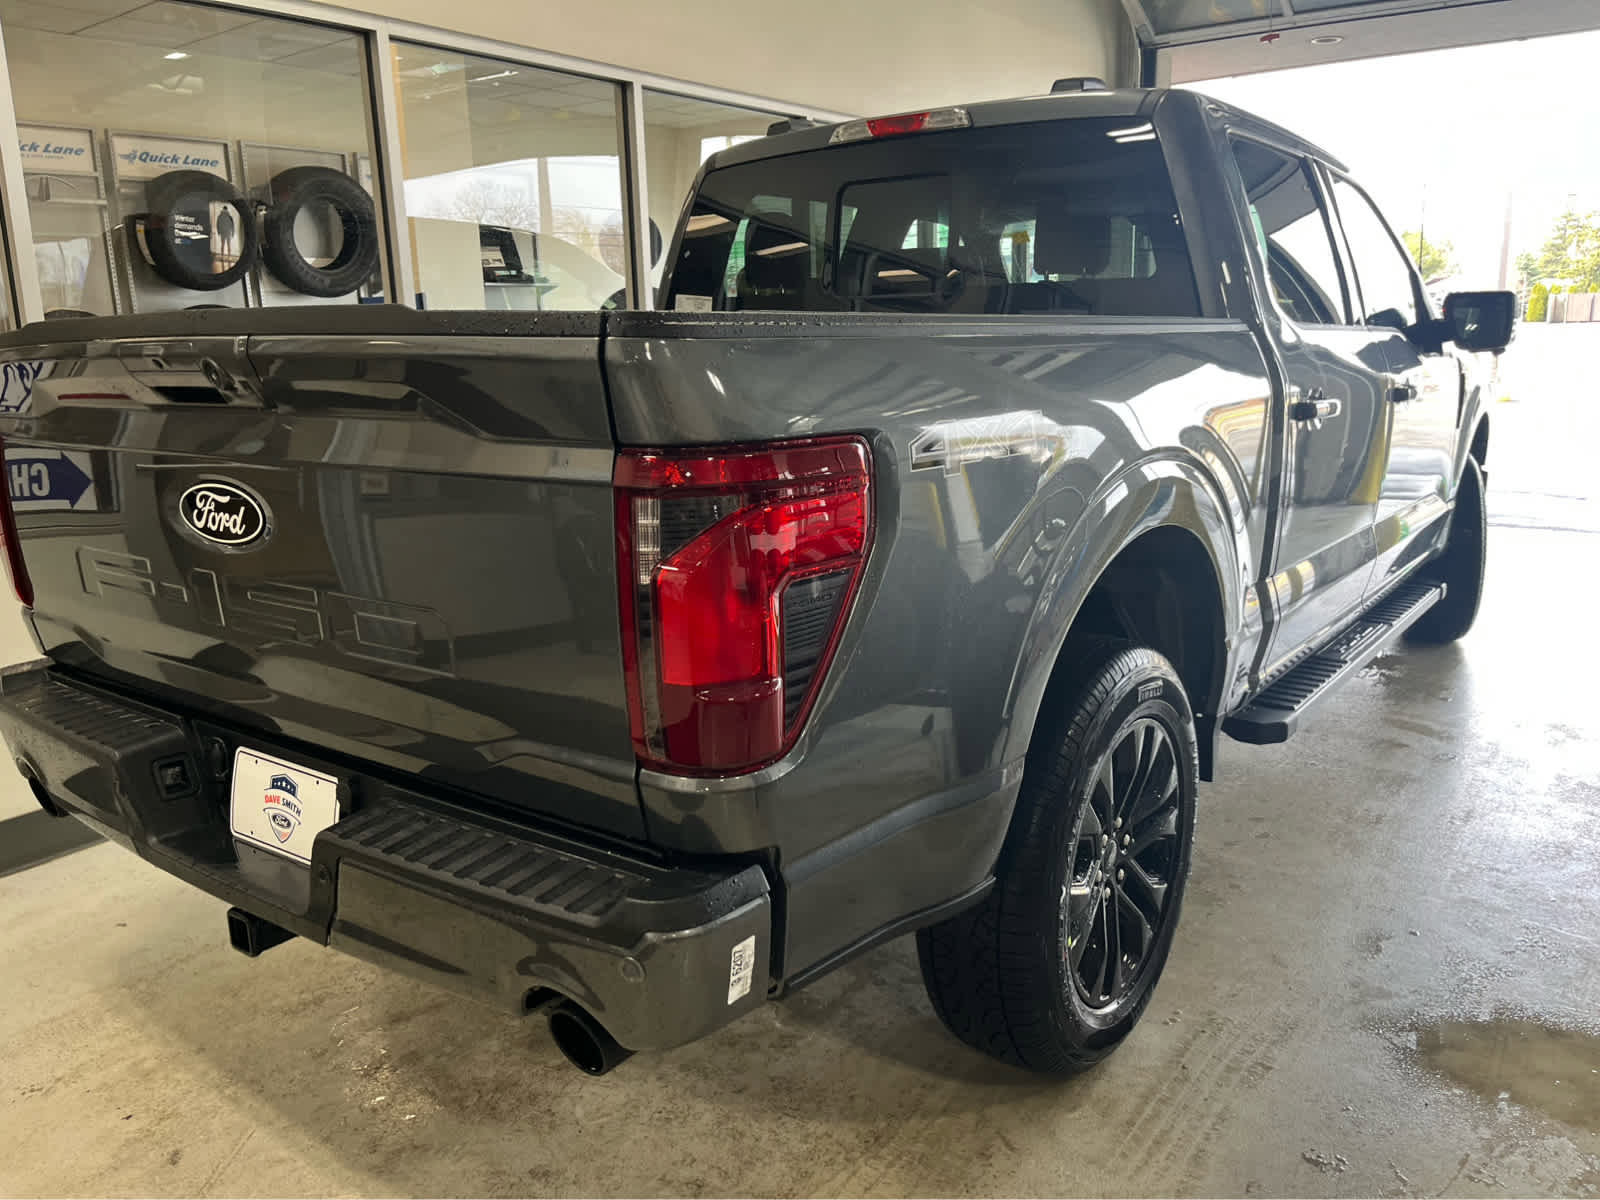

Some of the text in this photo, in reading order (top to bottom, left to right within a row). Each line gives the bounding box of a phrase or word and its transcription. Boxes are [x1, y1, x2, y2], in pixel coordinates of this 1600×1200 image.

[43, 143, 85, 156] Lane
[138, 151, 181, 165] Quick
[182, 154, 219, 168] Lane
[193, 490, 246, 535] Ford
[76, 545, 456, 678] F-150
[264, 795, 301, 816] DAVE SMITH
